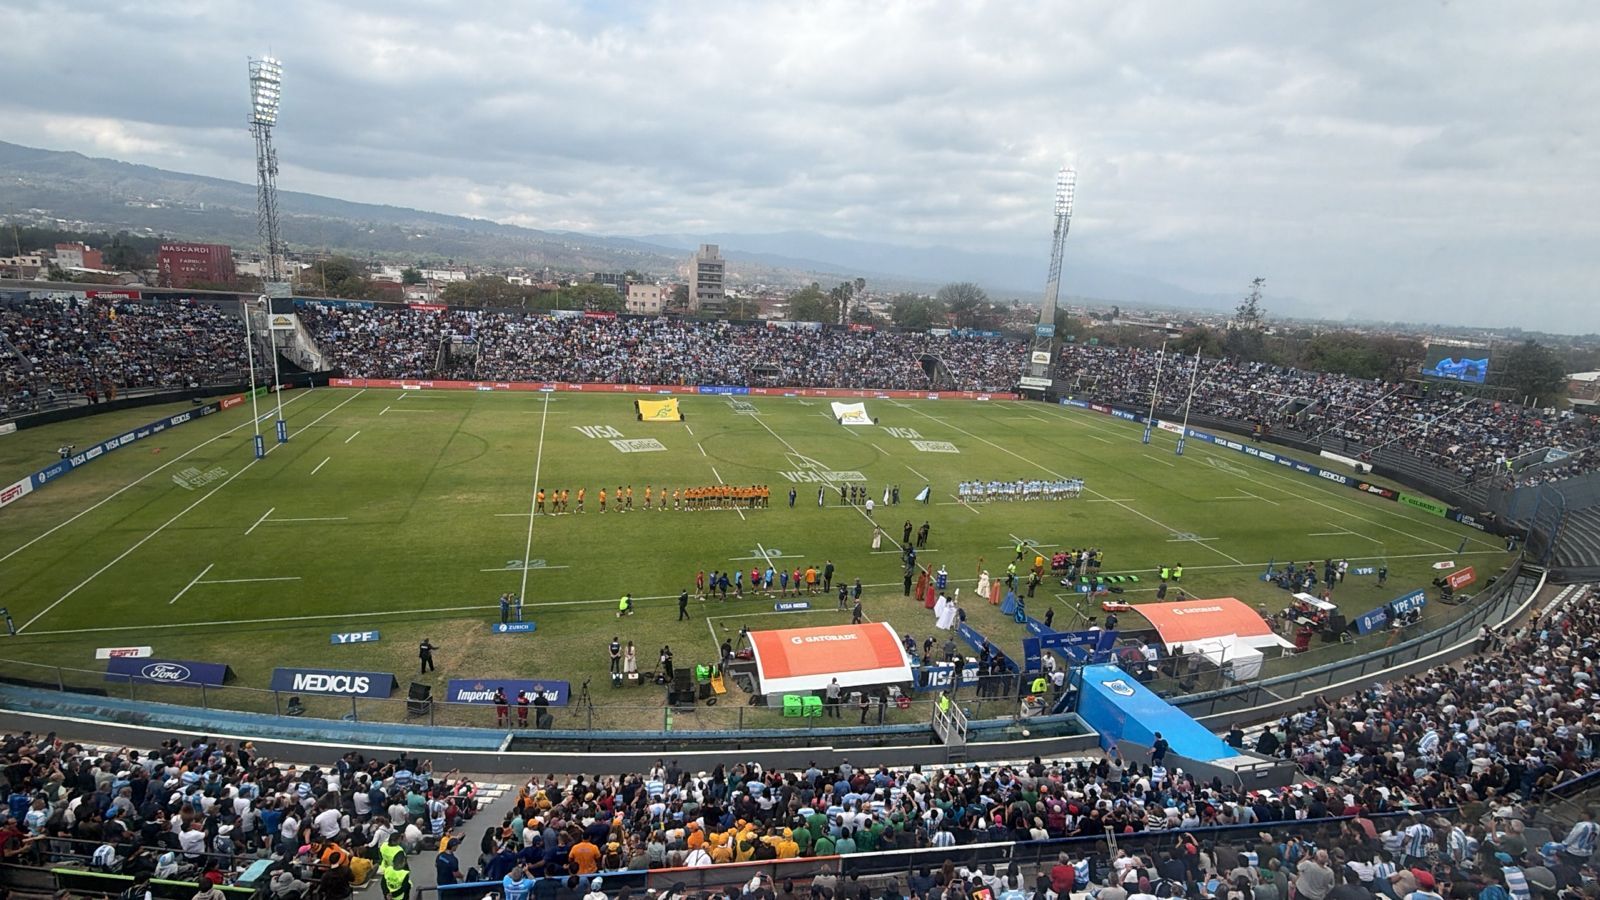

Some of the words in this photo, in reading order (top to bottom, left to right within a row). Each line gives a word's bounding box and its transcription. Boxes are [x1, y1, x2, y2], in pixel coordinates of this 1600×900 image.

[161, 245, 209, 254] MASCARDI
[570, 425, 624, 439] VISA
[878, 426, 925, 439] VISA
[105, 439, 120, 451] VISA
[1214, 437, 1227, 447] VISA
[1245, 447, 1258, 456] VISA
[69, 454, 87, 468] VISA
[777, 471, 823, 483] VISA
[1319, 469, 1346, 484] MEDICUS
[1357, 567, 1373, 575] YPF
[1393, 600, 1409, 614] YPF
[1410, 592, 1425, 606] YPF
[337, 631, 373, 643] YPF
[805, 633, 858, 643] GATORADE
[150, 664, 182, 680] Ford
[292, 673, 370, 694] MEDICUS
